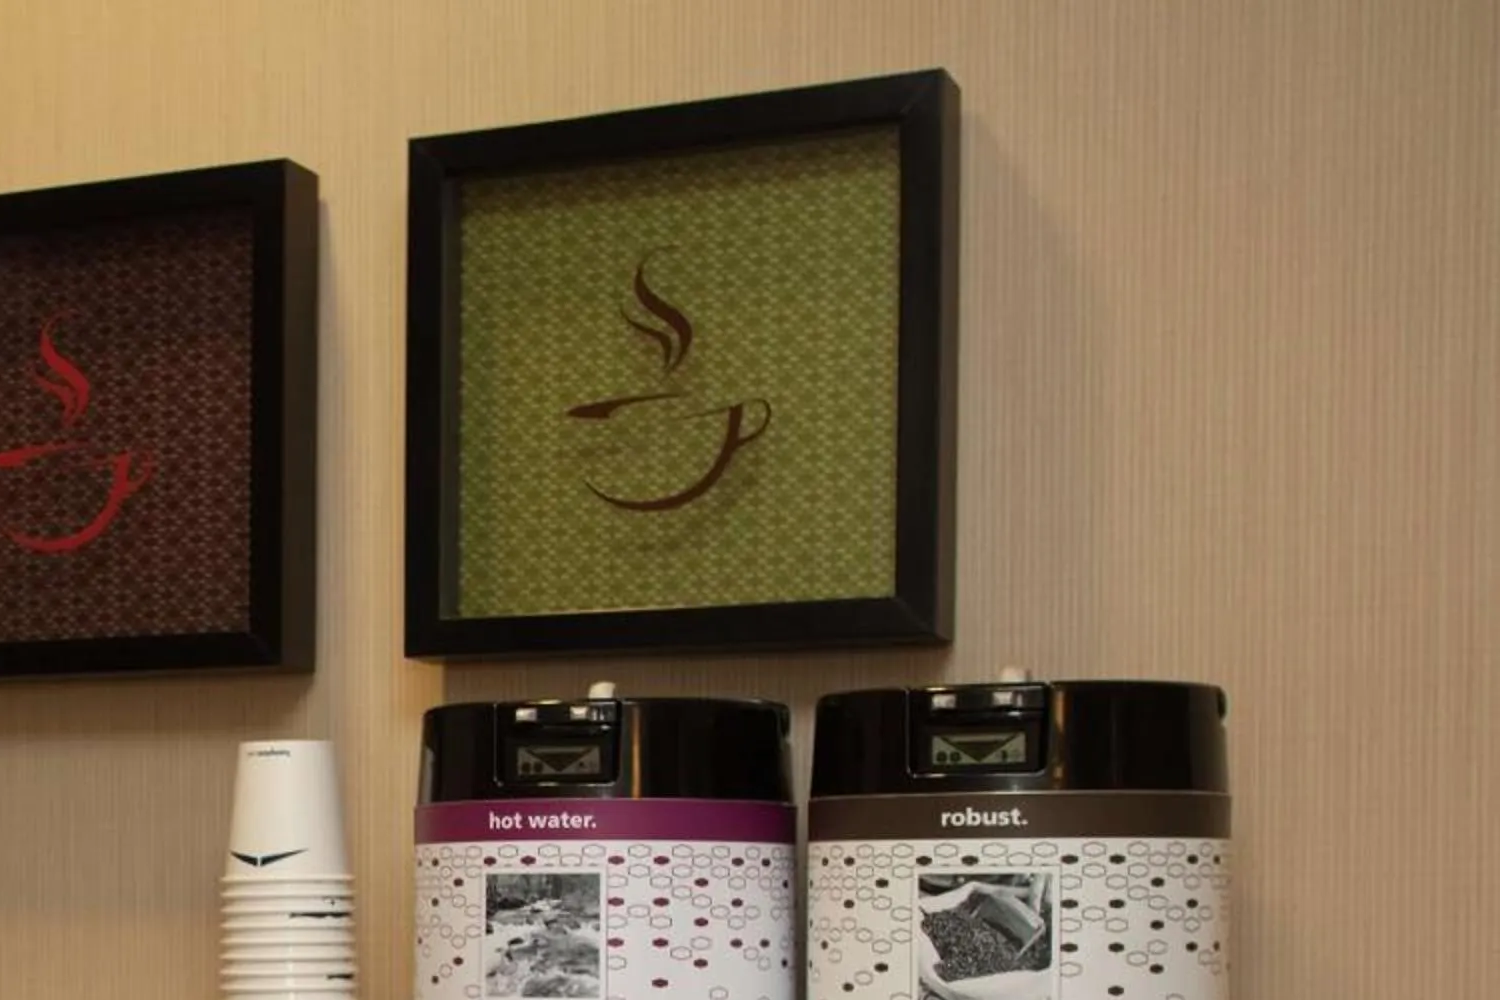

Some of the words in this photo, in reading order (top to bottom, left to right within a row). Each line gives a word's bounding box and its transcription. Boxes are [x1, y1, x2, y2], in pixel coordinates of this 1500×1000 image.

[488, 811, 524, 830] hot
[528, 810, 598, 830] water.
[940, 806, 1030, 829] robust.
